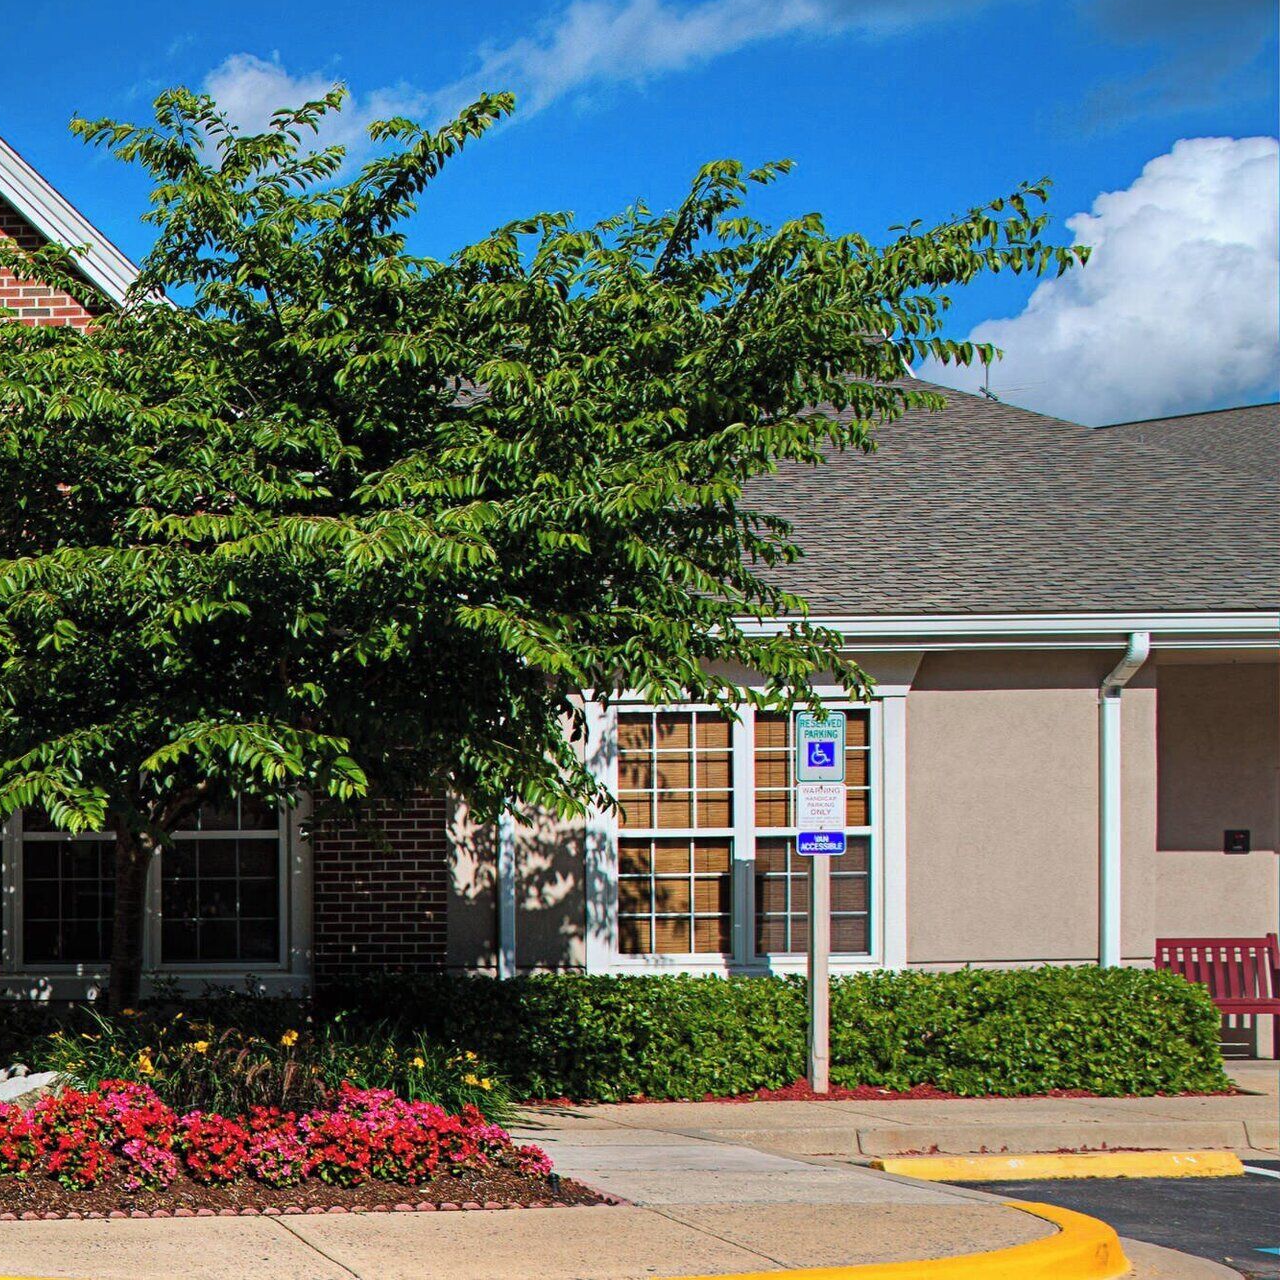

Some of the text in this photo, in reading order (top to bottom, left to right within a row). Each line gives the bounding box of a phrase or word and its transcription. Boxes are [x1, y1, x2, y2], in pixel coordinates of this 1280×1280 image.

[804, 729, 838, 739] PARKING
[814, 834, 830, 842] VAN
[800, 842, 843, 851] ACCESSIBLE
